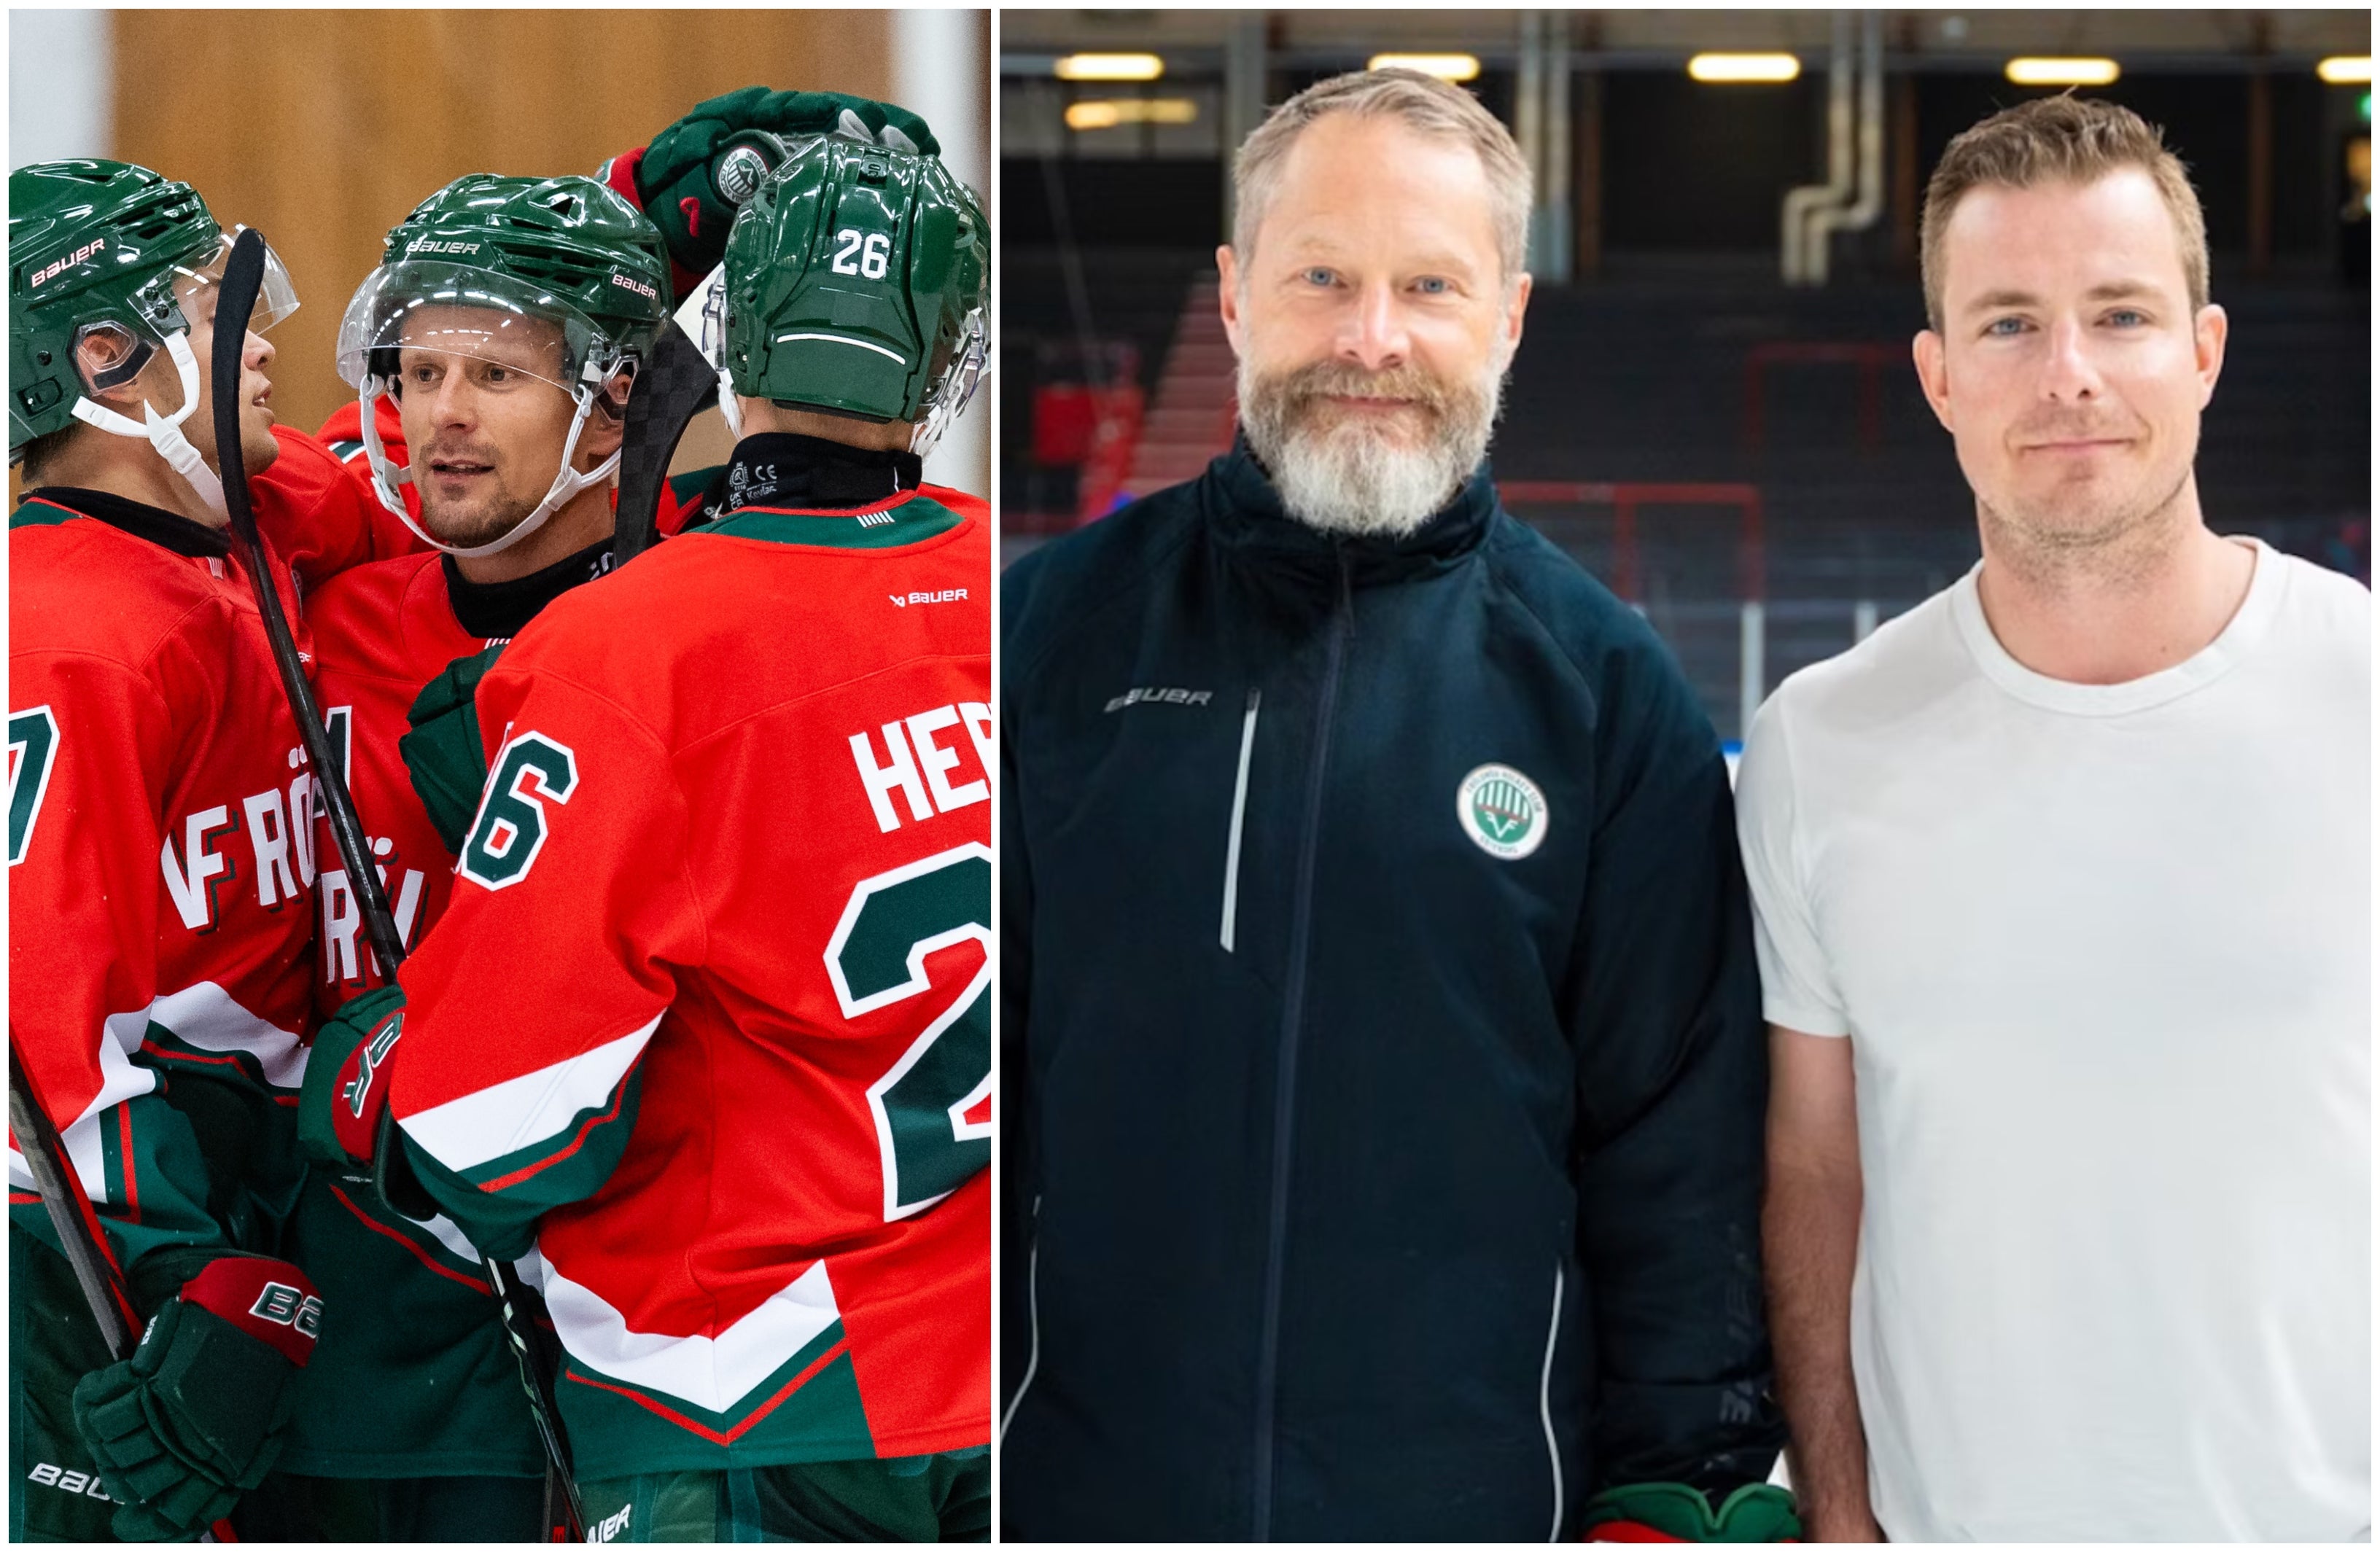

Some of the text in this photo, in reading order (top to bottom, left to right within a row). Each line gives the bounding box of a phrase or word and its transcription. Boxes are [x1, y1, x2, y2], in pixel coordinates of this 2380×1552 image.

[405, 241, 481, 254] BAUER
[832, 228, 890, 279] 26
[31, 238, 105, 288] BAUER
[612, 274, 656, 300] BAUER
[755, 464, 777, 480] CE
[908, 588, 968, 604] BAUER
[451, 721, 579, 892] 6
